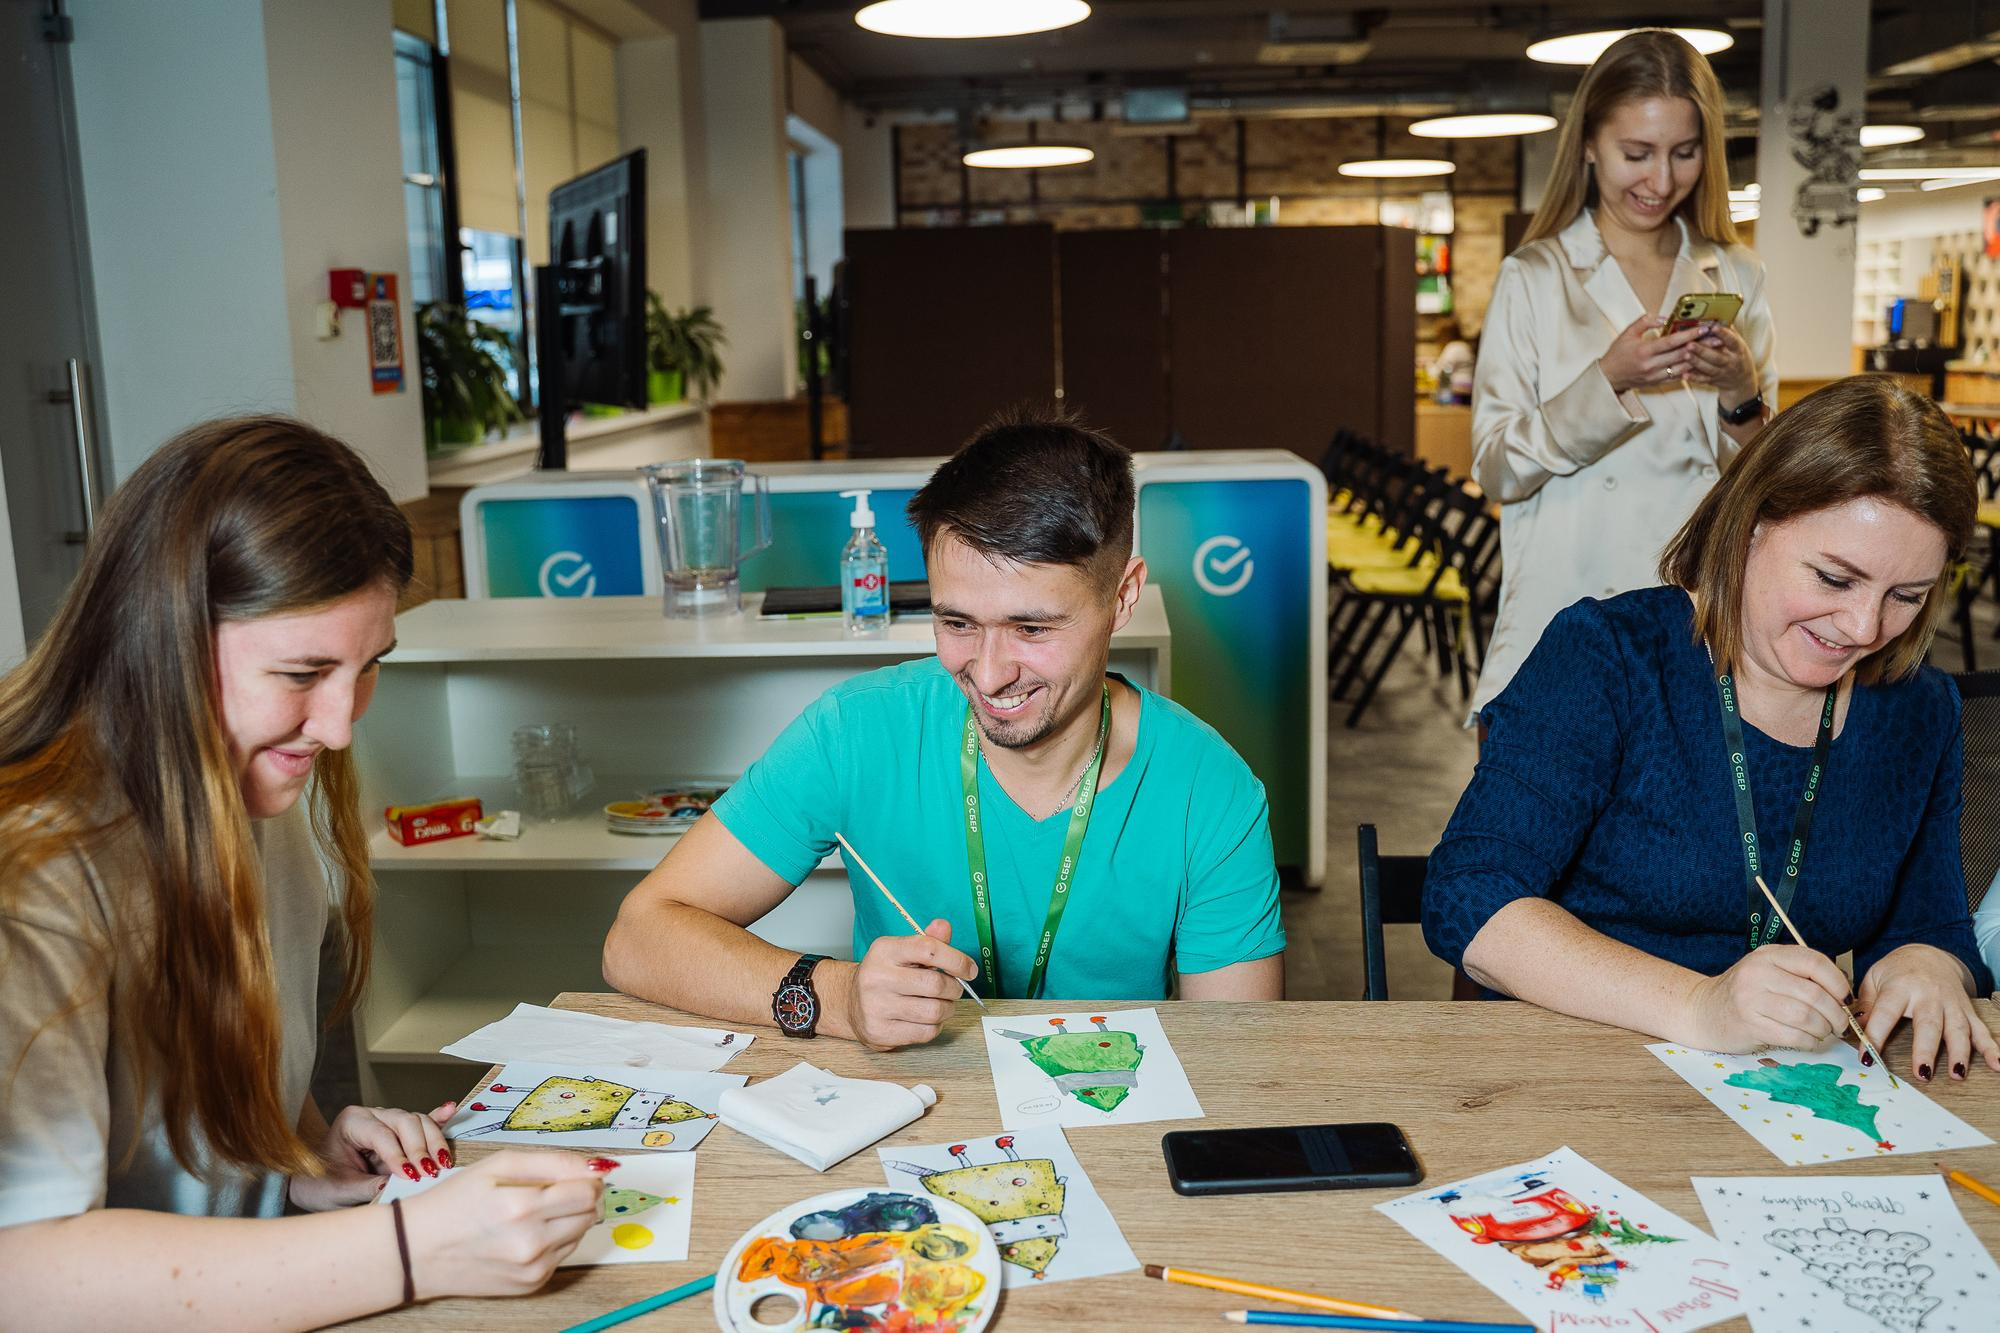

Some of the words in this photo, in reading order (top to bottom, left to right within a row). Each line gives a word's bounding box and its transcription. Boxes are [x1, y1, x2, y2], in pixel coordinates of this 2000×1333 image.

[1722, 687, 1734, 712] СБЕР
[1825, 692, 1834, 717] СБЕР
[966, 731, 975, 755] СБЕР
[1735, 766, 1746, 791] СБЕР
[1808, 764, 1820, 790] СБЕР
[1078, 778, 1092, 804] СБЕР
[968, 807, 978, 833] СБЕР
[1747, 845, 1758, 871] СБЕР
[1790, 839, 1802, 864] СБЕР
[1060, 855, 1072, 881] СБЕР
[975, 884, 986, 909] СБЕР
[1750, 926, 1759, 949] СБЕР
[1766, 915, 1781, 940] СБЕР
[1039, 930, 1051, 955] СБЕР
[1842, 1190, 1905, 1215] Merry
